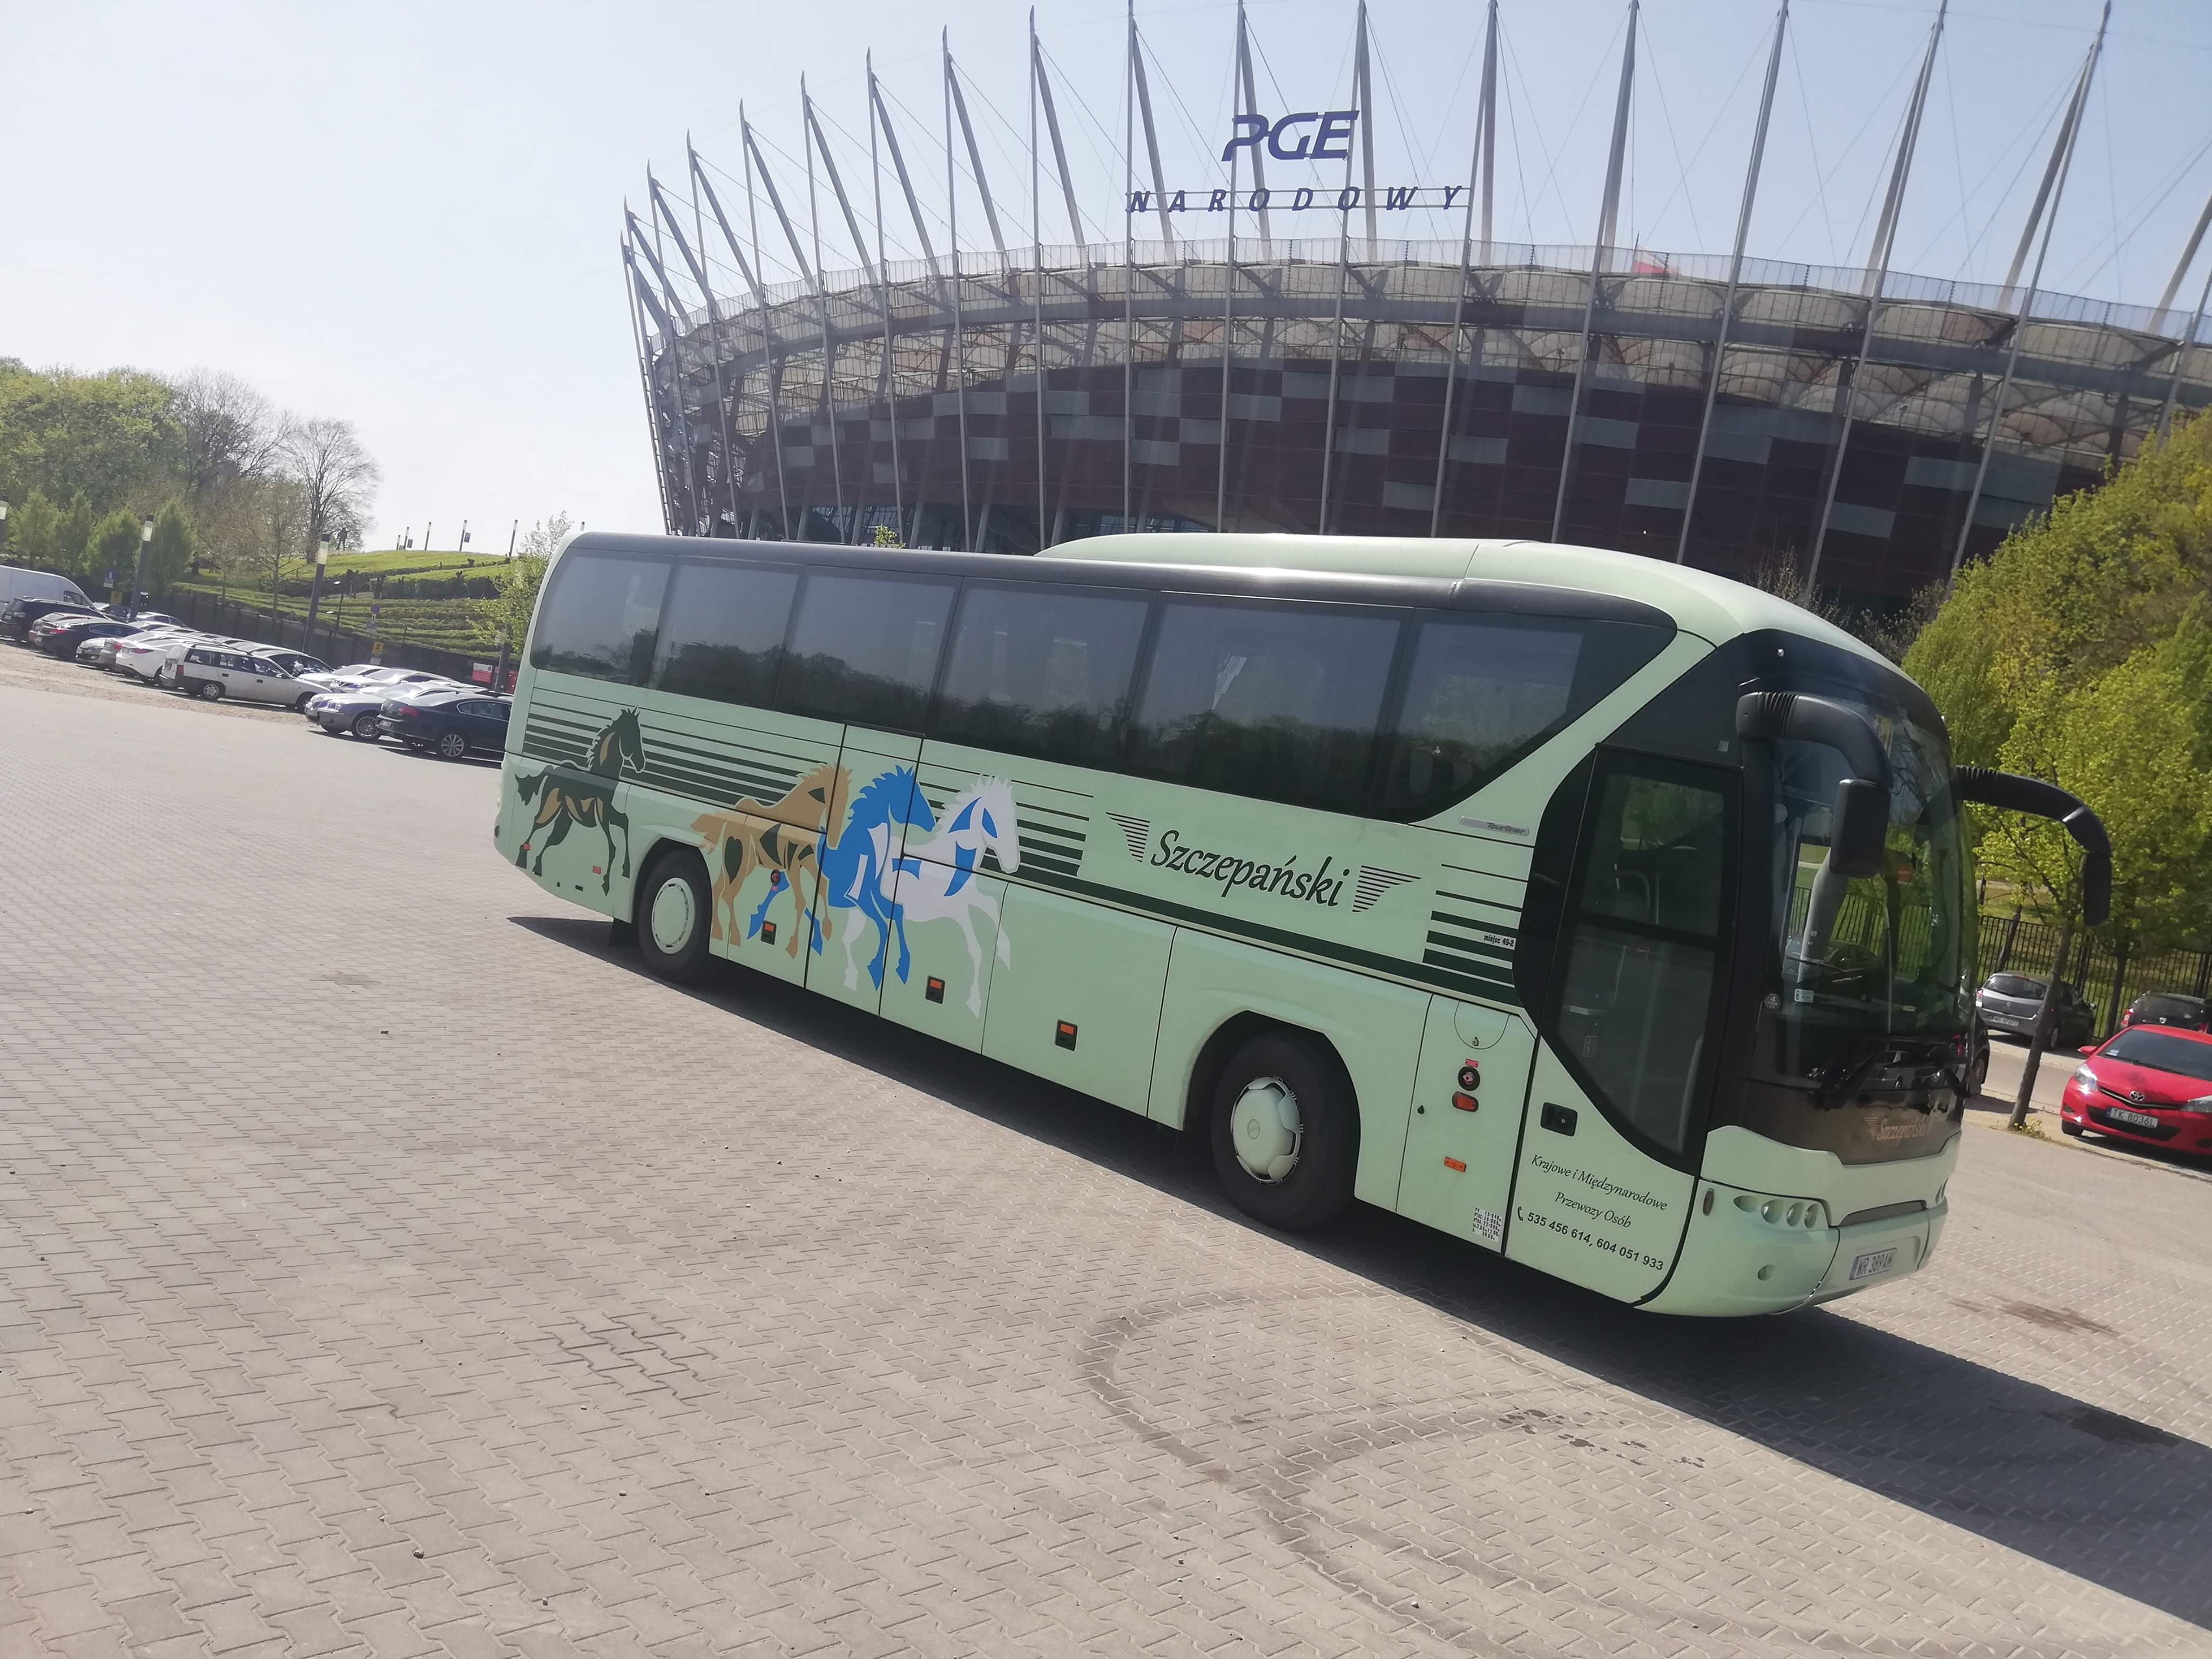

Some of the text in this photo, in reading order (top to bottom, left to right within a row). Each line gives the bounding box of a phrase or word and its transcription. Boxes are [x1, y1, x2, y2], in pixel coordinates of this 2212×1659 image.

[1220, 110, 1359, 161] PGE
[1128, 186, 1462, 212] NARODOWY
[1486, 821, 1526, 834] Tourliner
[1150, 830, 1350, 907] Szczepański
[2113, 1108, 2125, 1120] TK
[1531, 1154, 1668, 1211] Krajowe i Międzynarodowe
[1555, 1191, 1632, 1228] Przewozy Osób
[1527, 1212, 1664, 1271] 535 456 614, 604 051 933
